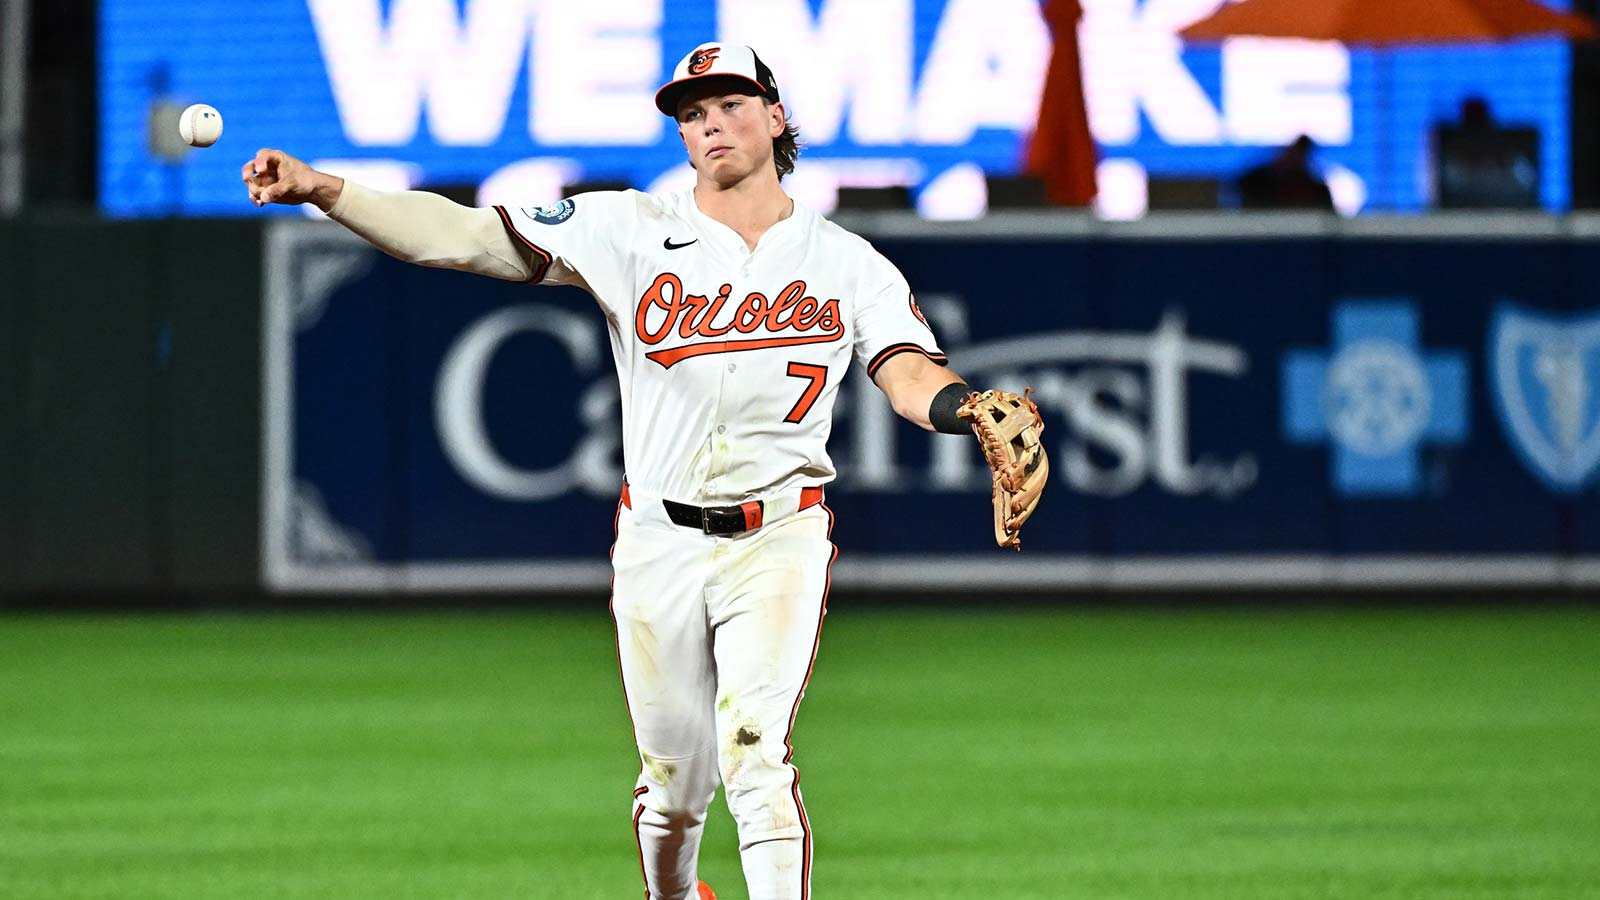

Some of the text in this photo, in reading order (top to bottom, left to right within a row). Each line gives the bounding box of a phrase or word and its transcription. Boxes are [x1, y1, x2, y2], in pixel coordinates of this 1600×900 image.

[308, 0, 1351, 147] WE MAKE
[635, 272, 845, 369] Orioles
[782, 361, 828, 424] 7
[750, 511, 757, 527] 7
